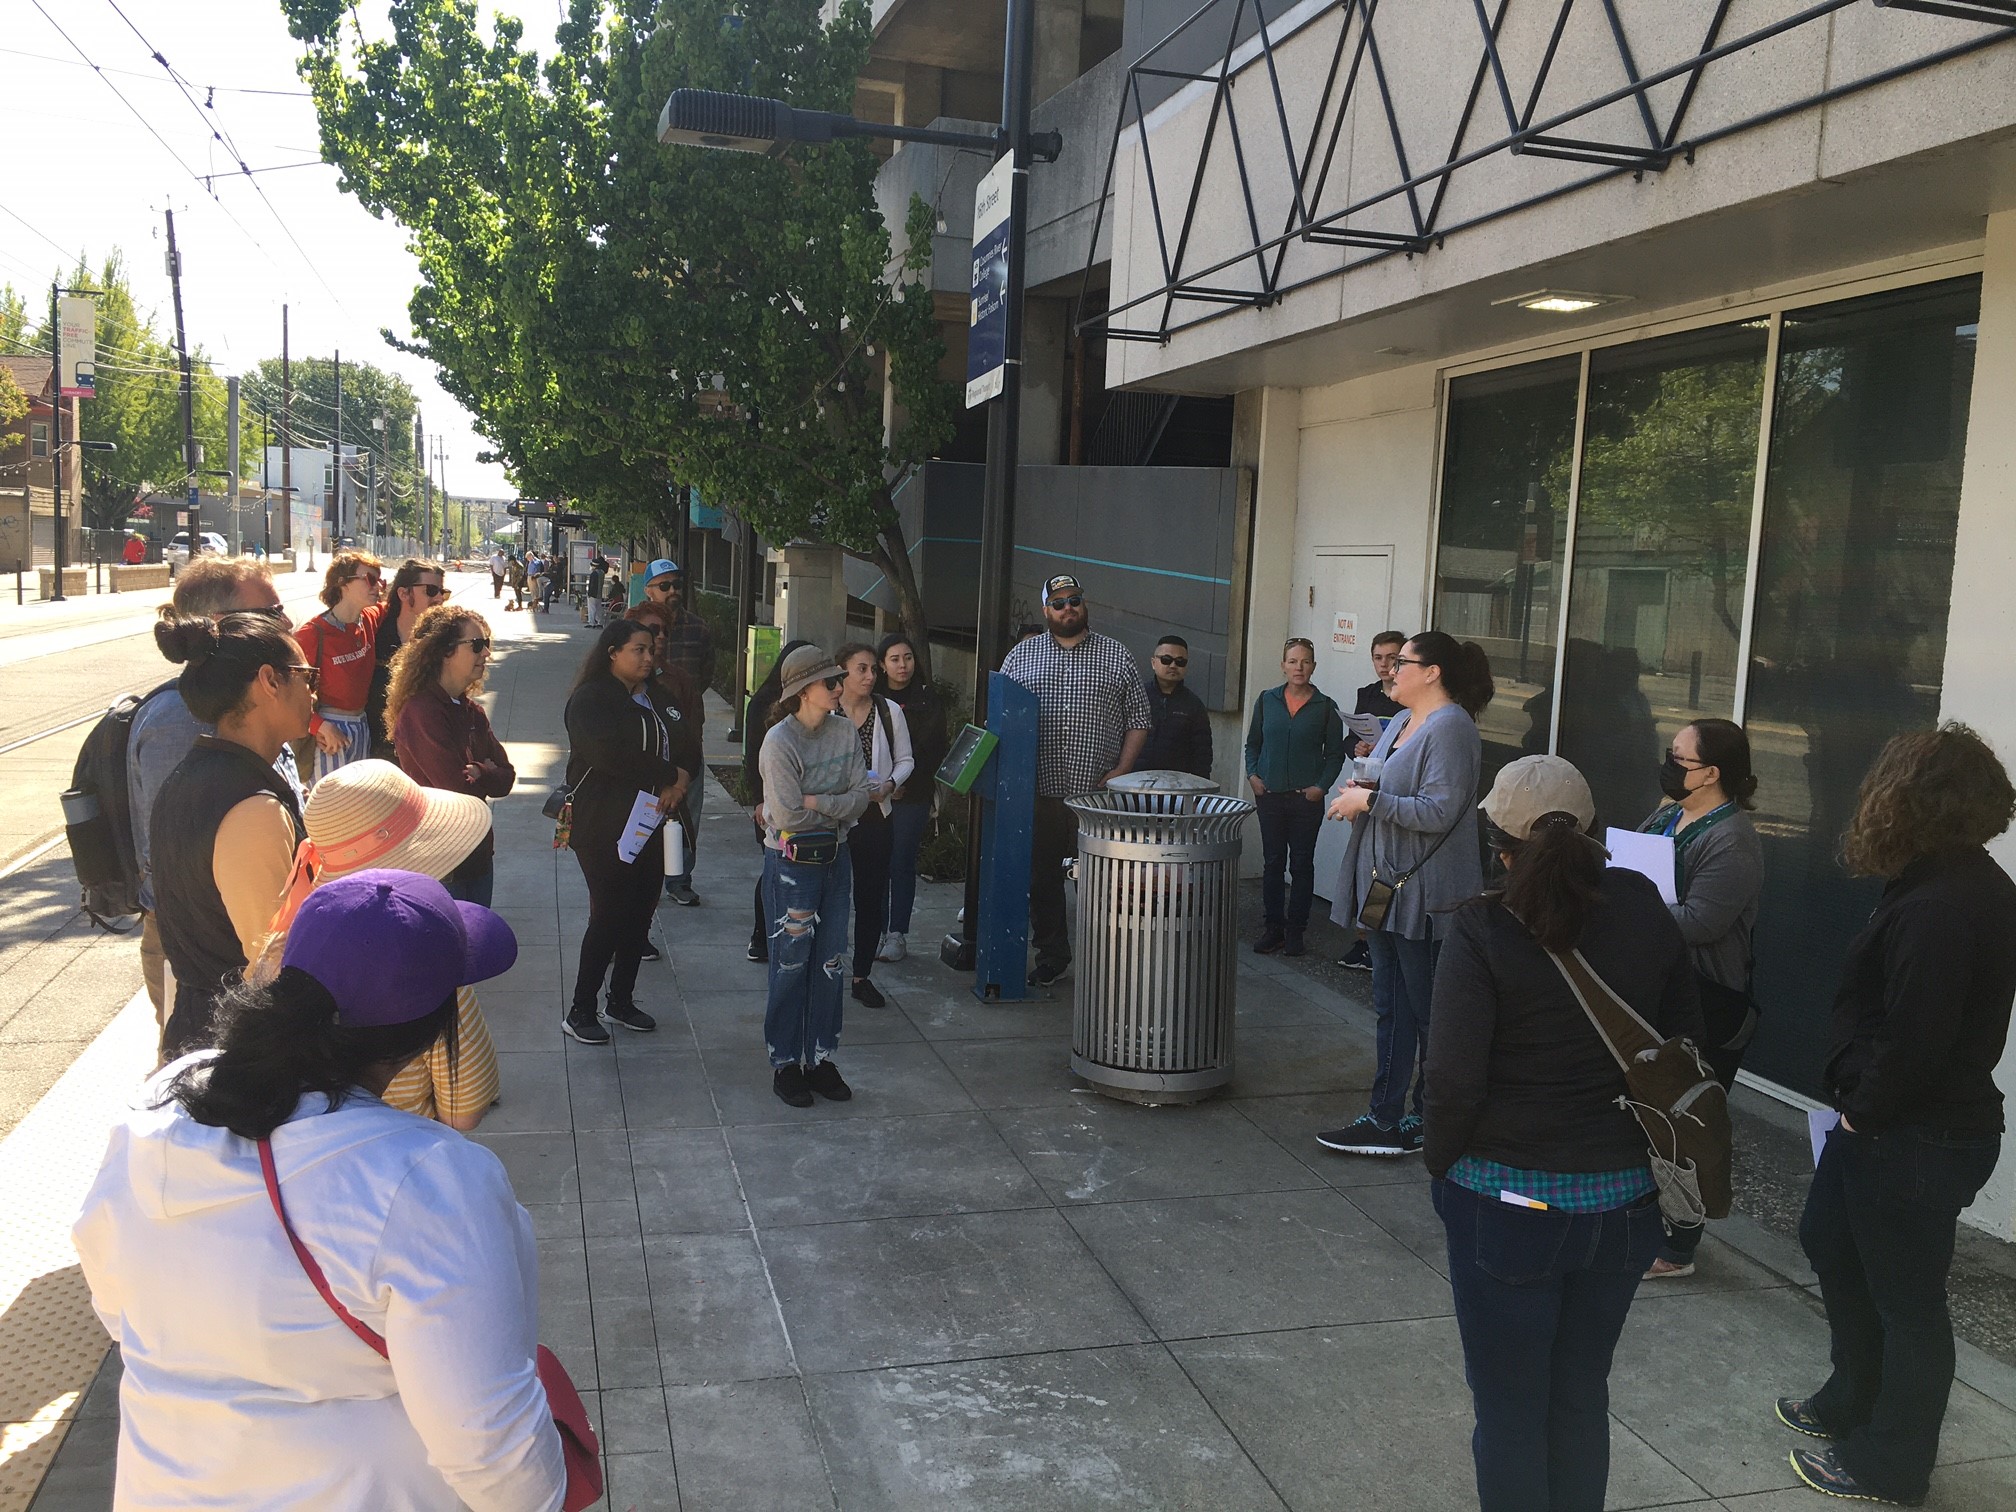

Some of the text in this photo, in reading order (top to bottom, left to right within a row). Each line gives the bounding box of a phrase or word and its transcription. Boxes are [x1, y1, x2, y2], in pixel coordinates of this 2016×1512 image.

[986, 187, 999, 211] Street
[979, 266, 990, 282] College
[1338, 619, 1353, 629] NOT AN
[1333, 633, 1355, 645] ENTRANCE
